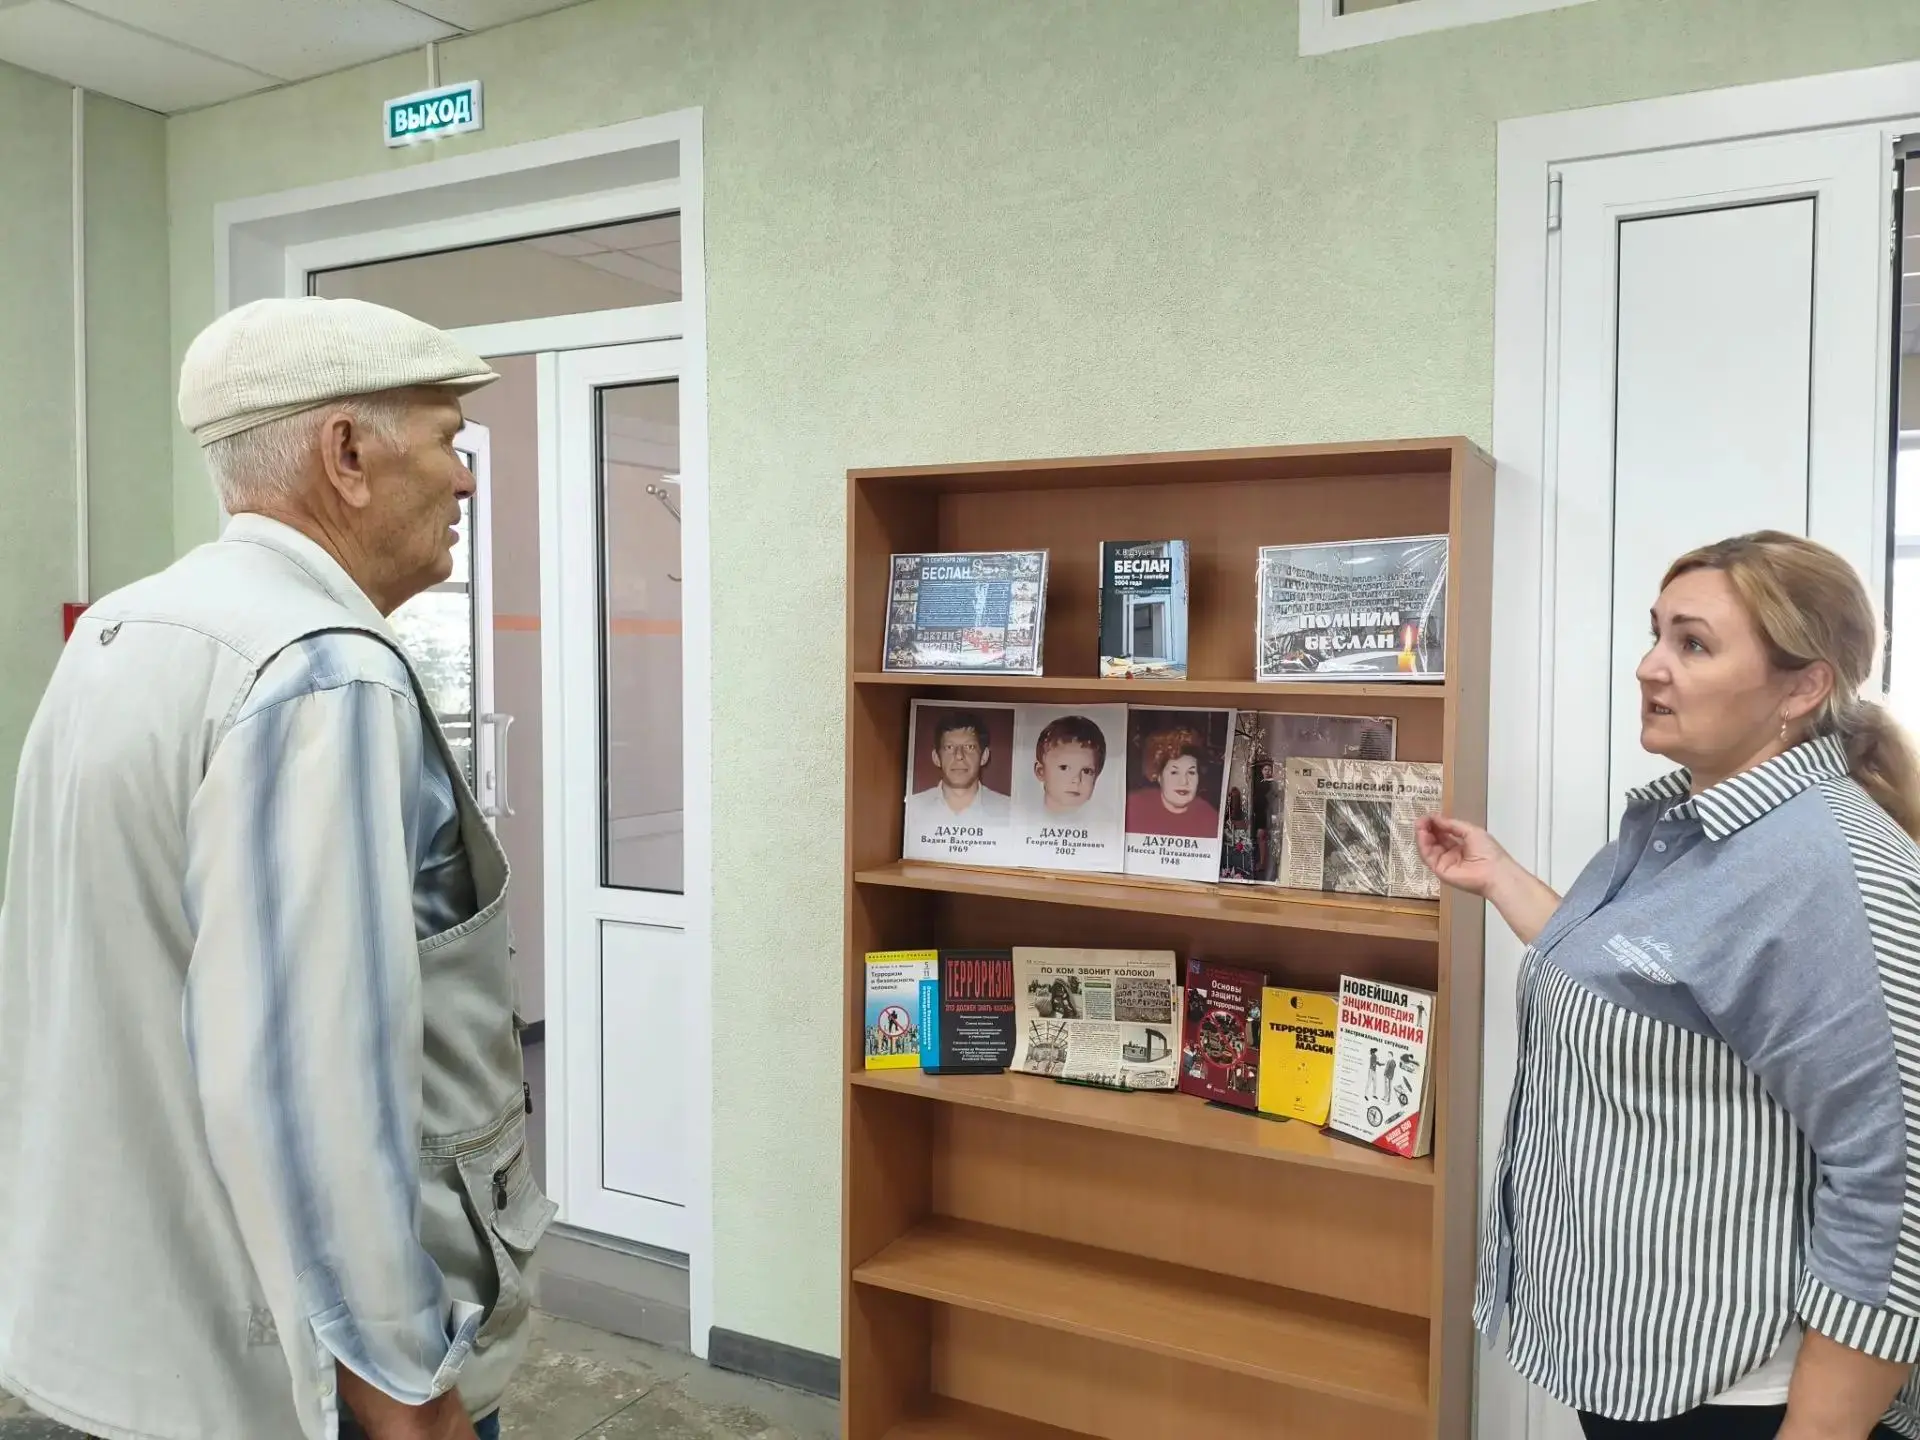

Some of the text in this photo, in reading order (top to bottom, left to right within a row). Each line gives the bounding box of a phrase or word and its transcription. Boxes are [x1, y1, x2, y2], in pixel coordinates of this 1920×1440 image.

[395, 95, 471, 132] ВЫХОД
[922, 566, 971, 580] БЕСЛАН
[1114, 560, 1170, 573] БЕСЛАН
[1300, 612, 1400, 629] ПОМНИМ
[1305, 634, 1395, 650] БЕСЛАН
[1317, 778, 1393, 793] Бесланский
[1397, 782, 1439, 795] роман
[934, 826, 984, 837] ДАУРОВ
[1039, 828, 1089, 839] ДАУРОВ
[921, 836, 997, 846] Вадим Валерьевич
[1026, 837, 1105, 849] Георгий Вадимович
[1143, 836, 1200, 849] ДАУРОВА
[1055, 847, 1076, 856] 2002
[1127, 846, 1155, 855] Инесса
[1161, 857, 1181, 865] 1948
[947, 960, 1012, 998] ТЕРРОРИЗМ
[1078, 968, 1111, 976] ЗВОНИТ
[1114, 969, 1155, 977] КОЛОКОЛ
[1211, 980, 1242, 994] Основы
[1210, 990, 1242, 1002] защиты
[1343, 980, 1408, 1008] НОВЕЙШАЯ
[1213, 1001, 1245, 1012] терроризма
[1342, 996, 1415, 1023] ЭНЦИКЛОПЕДИЯ
[1269, 1022, 1335, 1039] ТЕРРОРИЗМ
[1341, 1009, 1424, 1044] ВЫЖИВАНИЯ
[1295, 1033, 1317, 1044] БЕЗ
[1295, 1041, 1334, 1055] МАСКИ
